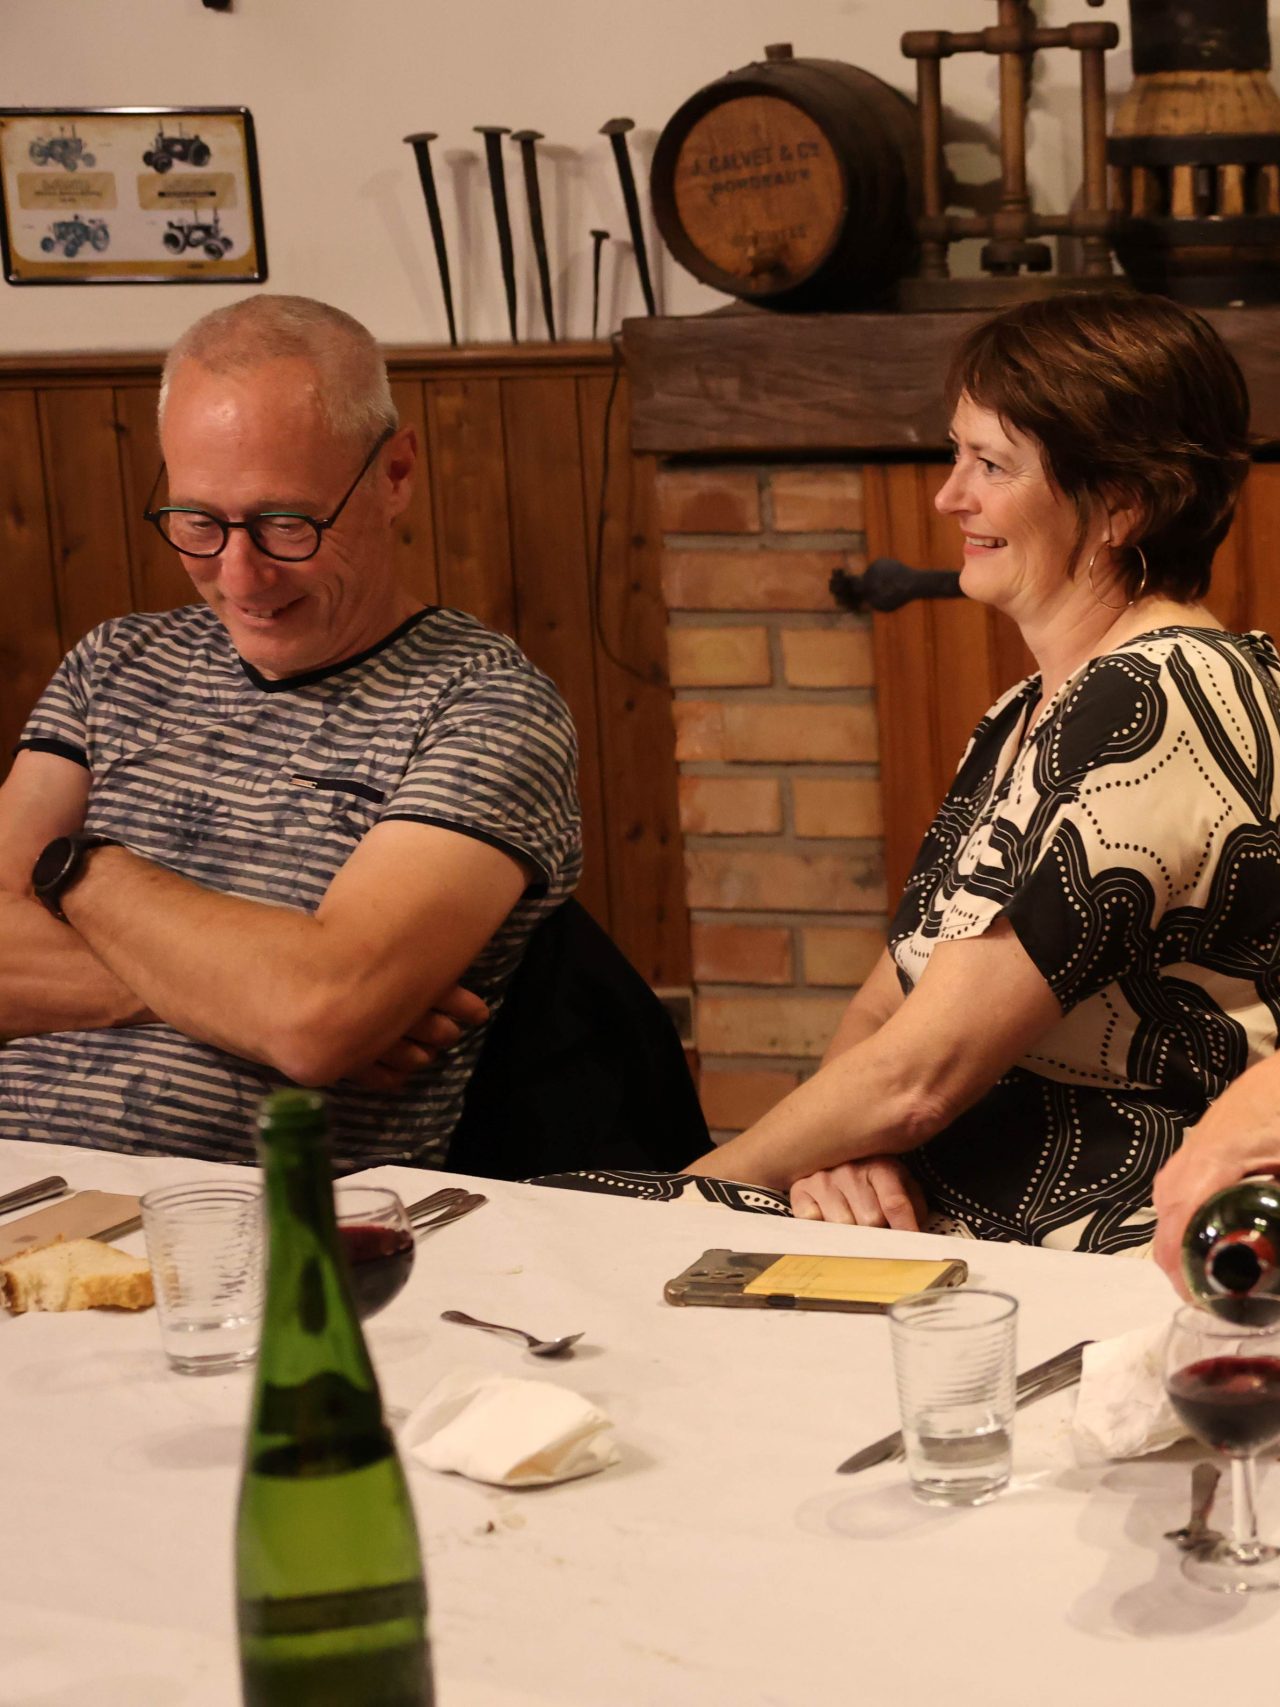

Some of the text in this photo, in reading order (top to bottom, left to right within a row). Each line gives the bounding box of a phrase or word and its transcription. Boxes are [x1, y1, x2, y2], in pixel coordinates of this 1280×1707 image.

[709, 146, 774, 173] CALVET
[781, 145, 793, 161] &
[712, 169, 810, 193] BORDEAUX
